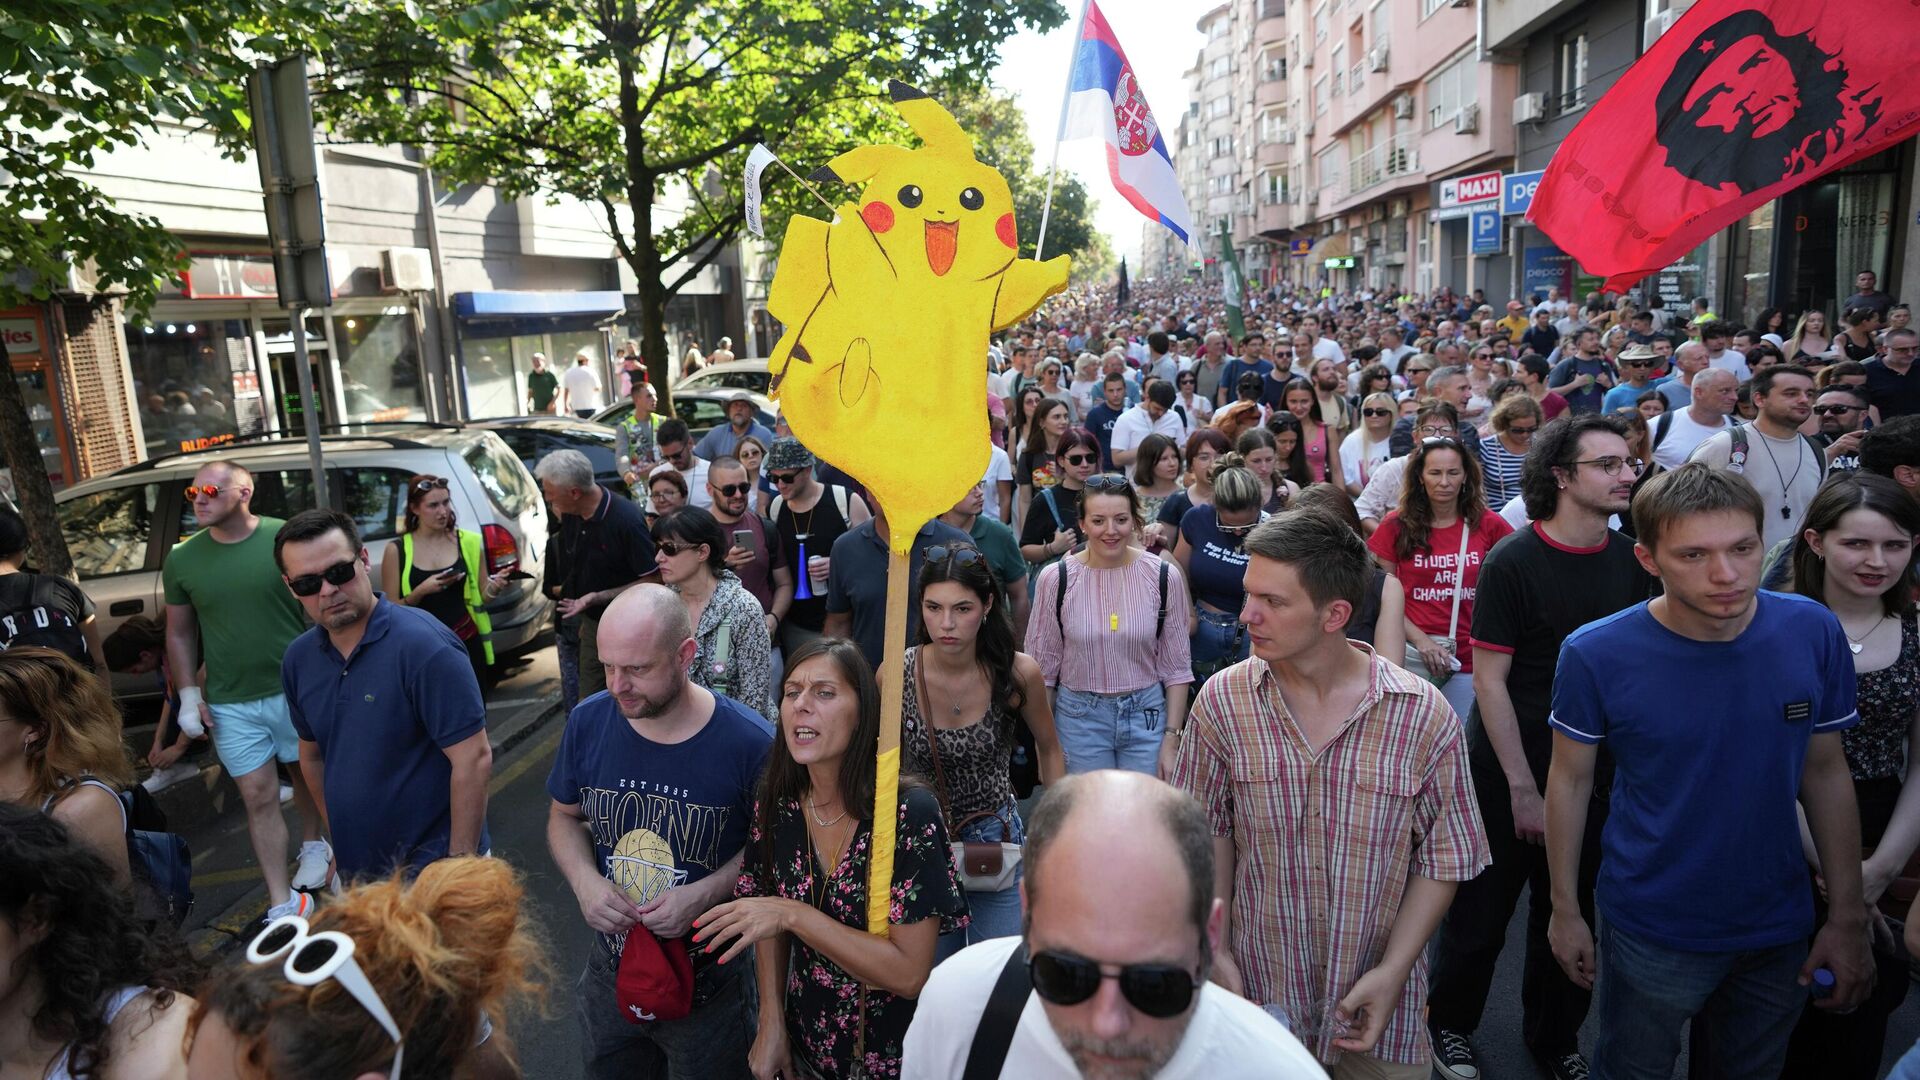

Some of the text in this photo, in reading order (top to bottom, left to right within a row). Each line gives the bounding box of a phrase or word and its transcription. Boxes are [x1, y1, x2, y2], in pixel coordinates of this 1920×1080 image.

[1459, 176, 1498, 199] MAXI
[1512, 181, 1536, 204] pe
[1479, 215, 1494, 235] P
[1526, 267, 1566, 279] pepco
[3, 329, 33, 344] ies
[1208, 550, 1245, 565] are better
[1414, 551, 1480, 569] STUDENTS
[1413, 586, 1476, 602] CHAMPNS
[619, 778, 647, 789] EST
